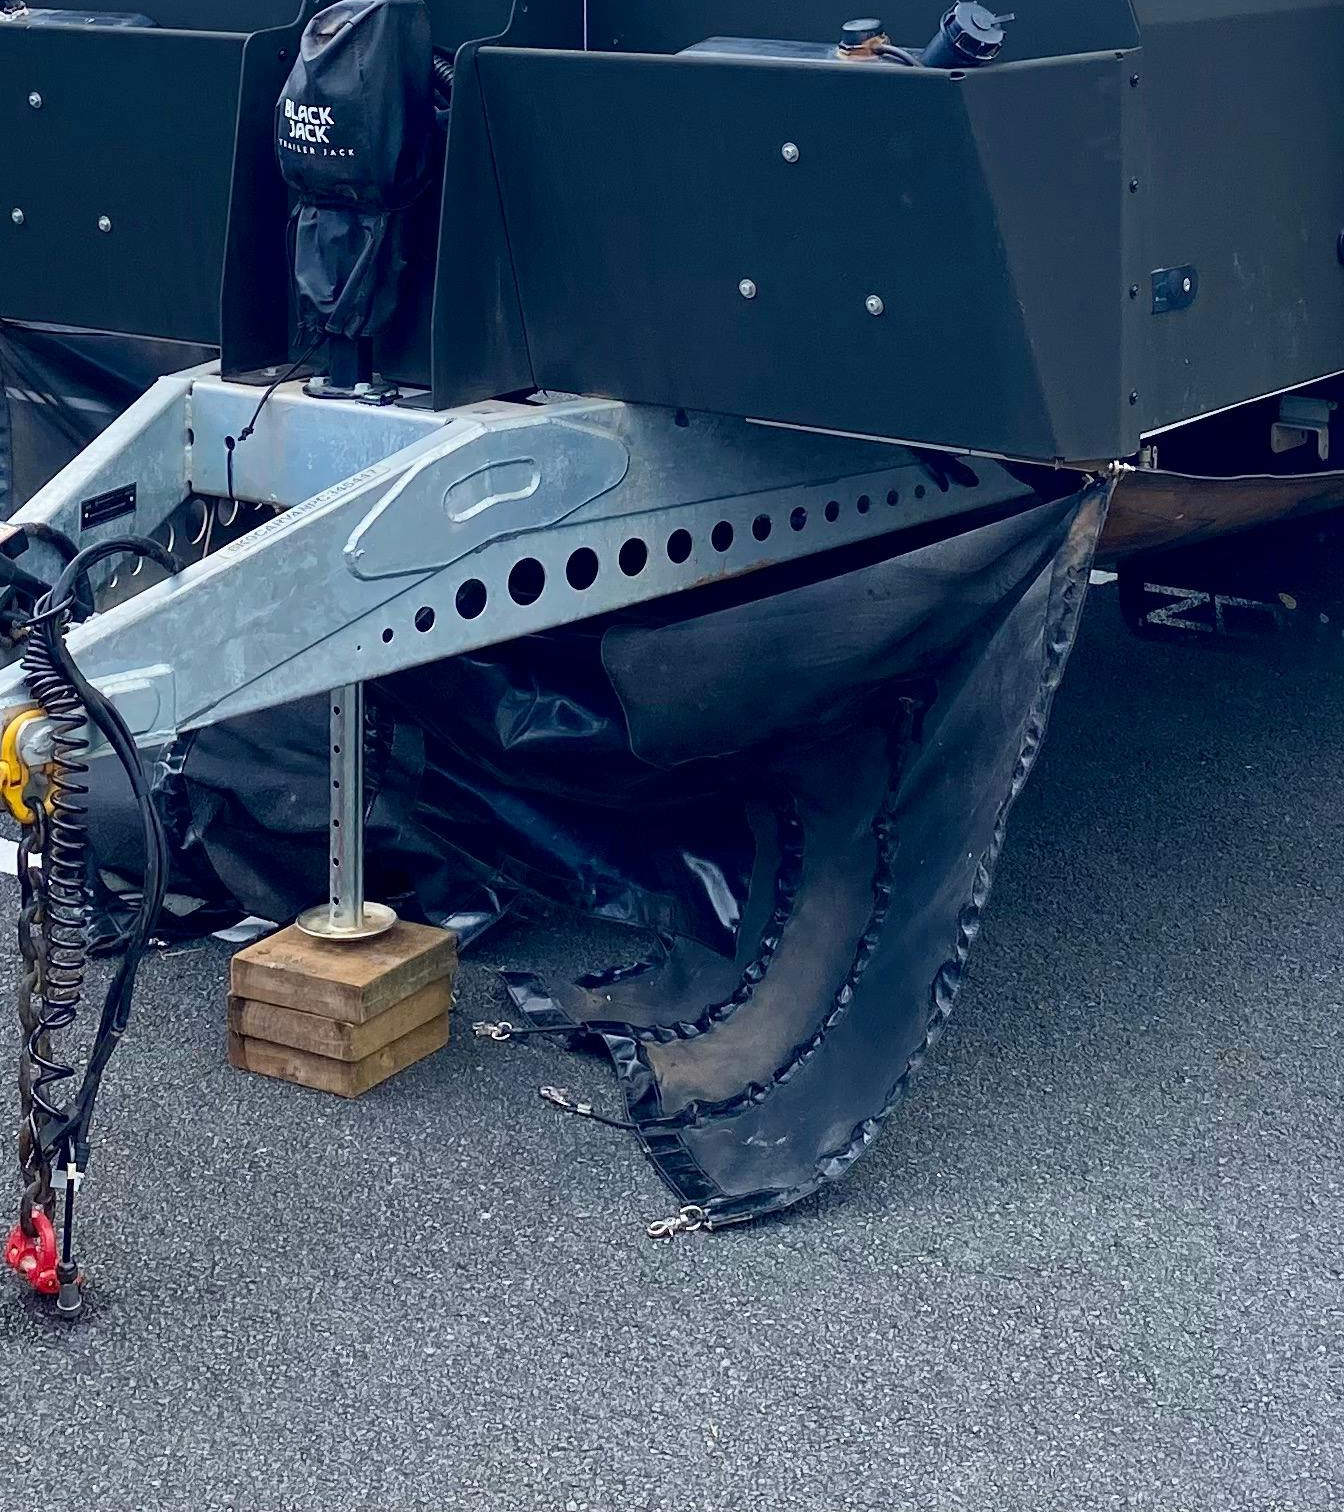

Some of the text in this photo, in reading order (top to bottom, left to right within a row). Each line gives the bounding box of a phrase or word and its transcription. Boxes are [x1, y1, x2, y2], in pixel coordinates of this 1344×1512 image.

[284, 98, 335, 125] BLACK
[289, 120, 330, 144] JACK
[278, 138, 355, 157] TRAILER JACK
